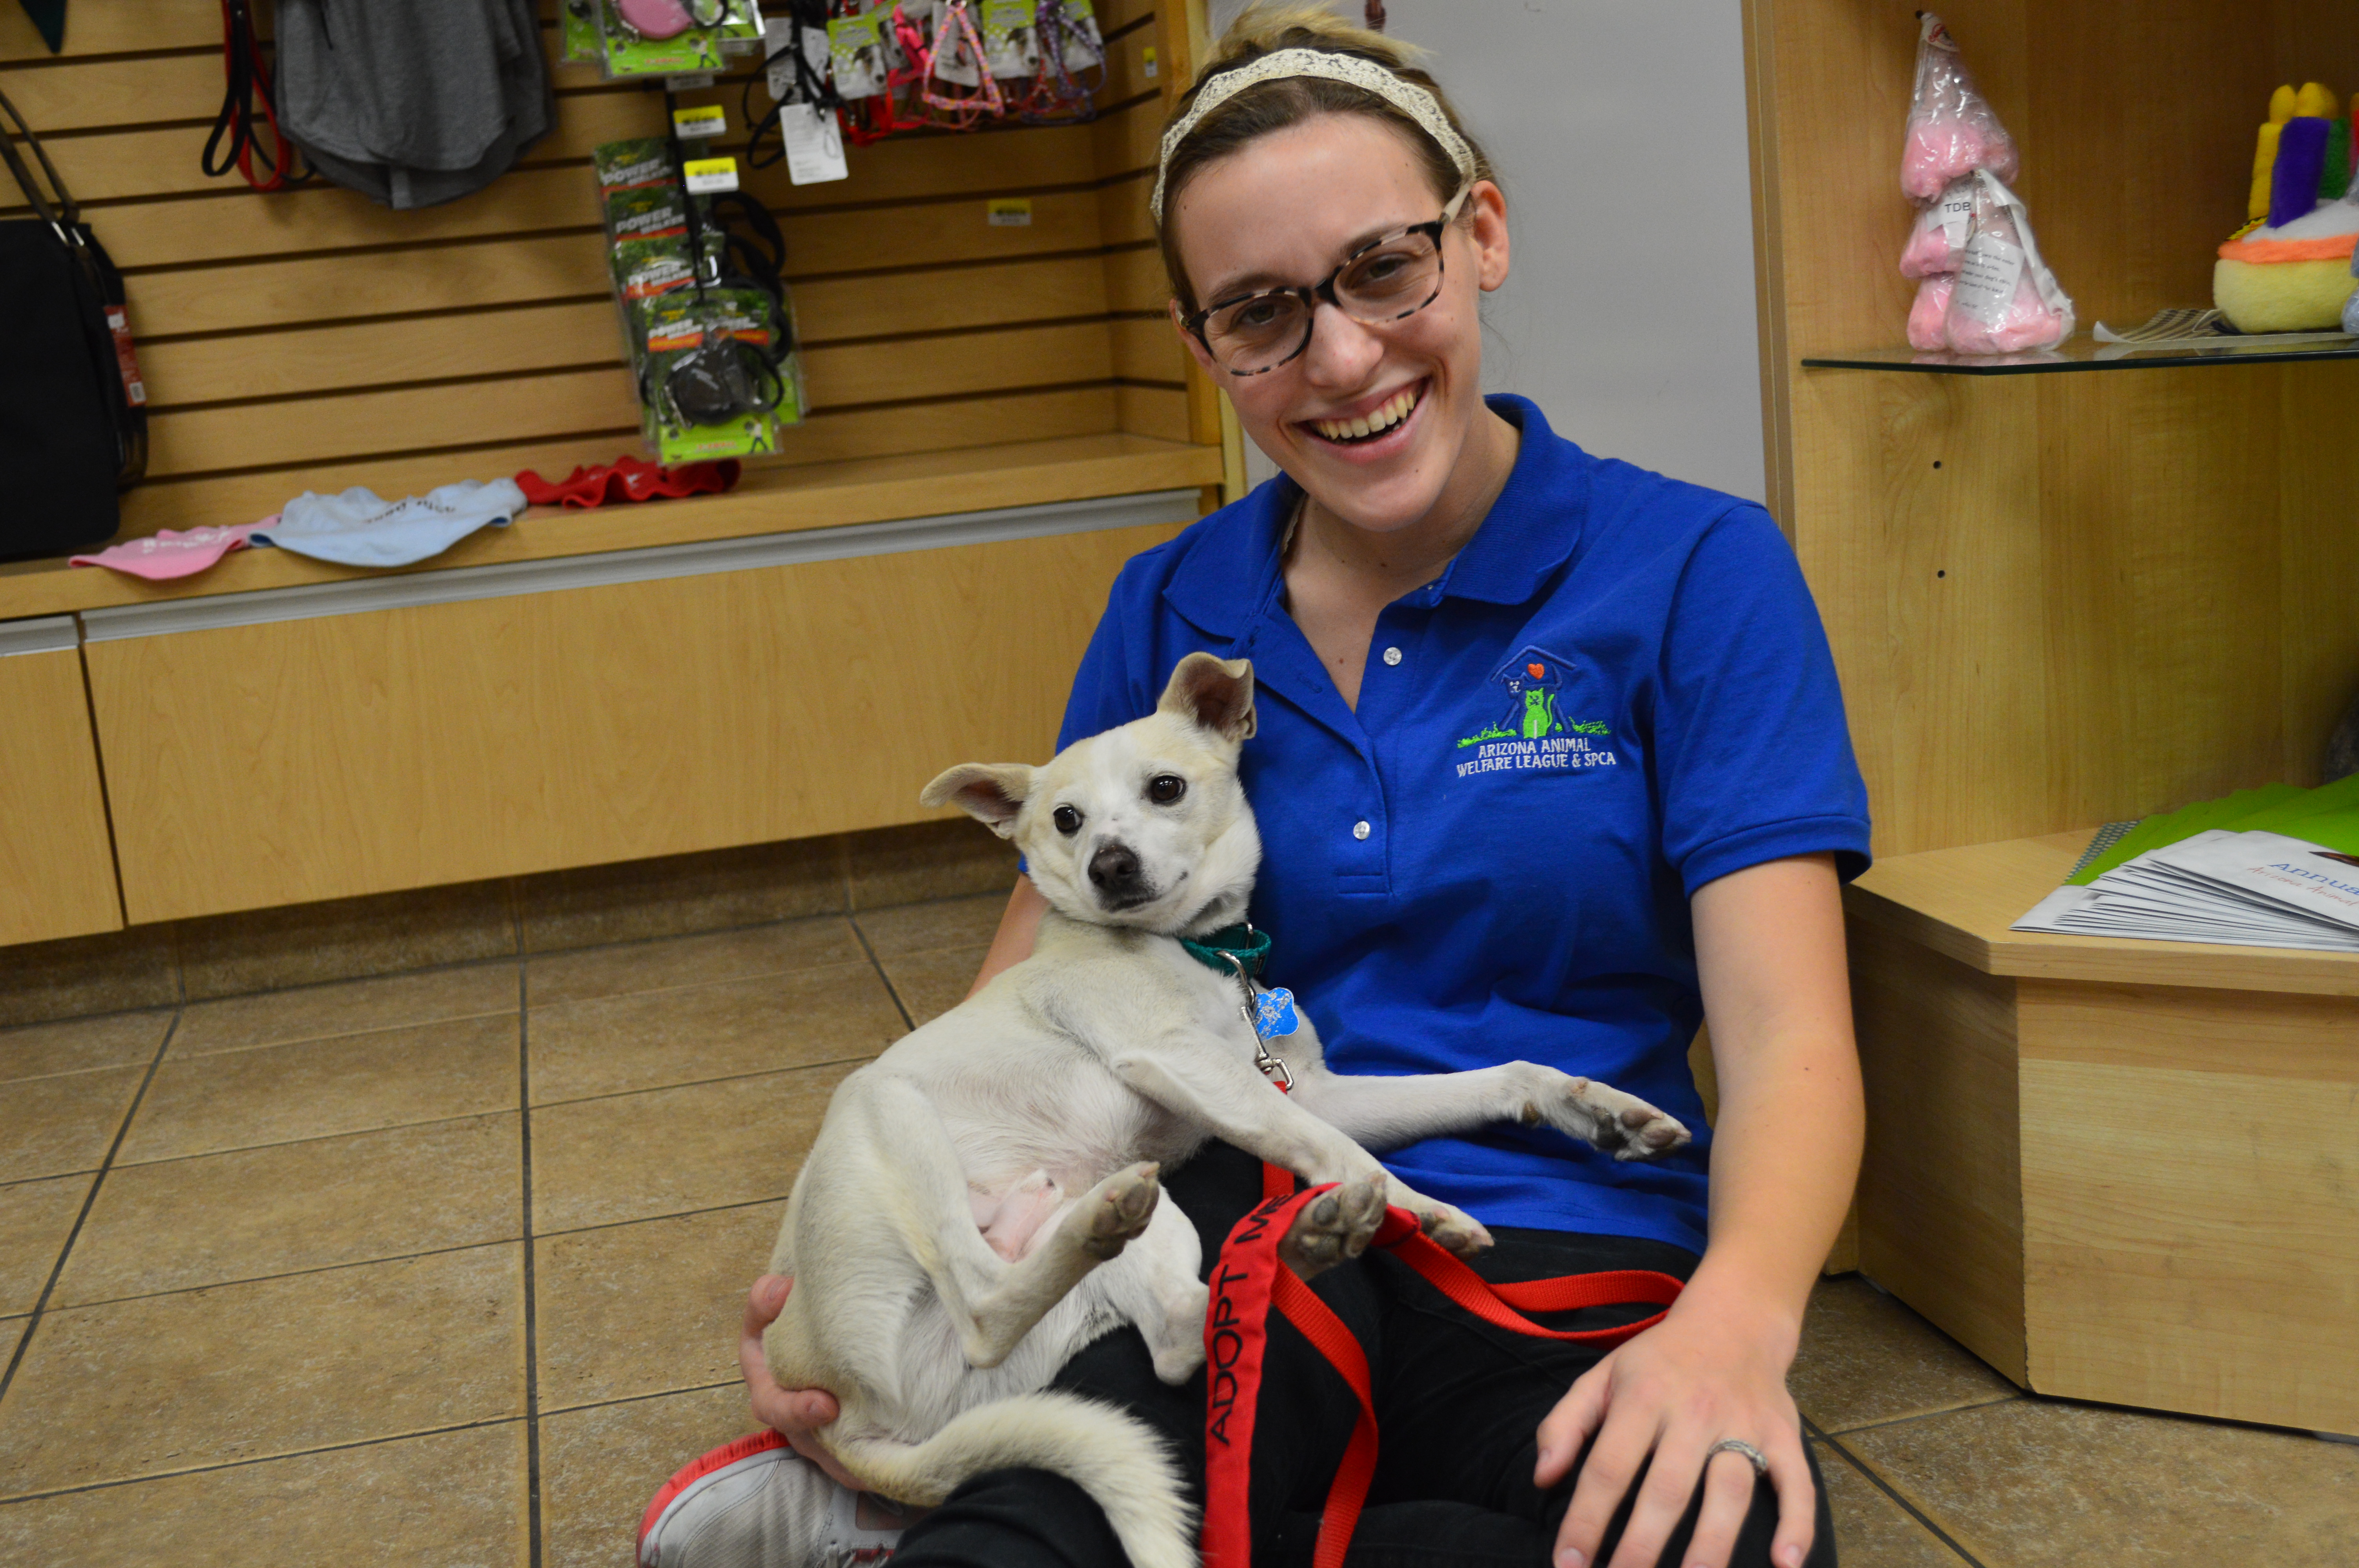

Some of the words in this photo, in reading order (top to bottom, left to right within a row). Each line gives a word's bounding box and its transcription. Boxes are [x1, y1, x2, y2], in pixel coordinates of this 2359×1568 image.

[616, 206, 672, 233] POWER
[1945, 201, 1971, 213] TDB
[1478, 741, 1537, 759] ARIZONA
[1541, 737, 1591, 753] ANIMAL
[1456, 757, 1513, 778] WELFARE
[1516, 753, 1569, 769] LEAGUE
[1572, 753, 1581, 768] &
[1584, 751, 1617, 767] SPCA
[2247, 867, 2303, 887] Arizona
[2306, 886, 2359, 907] Animal
[1210, 1264, 1249, 1447] ADOPT
